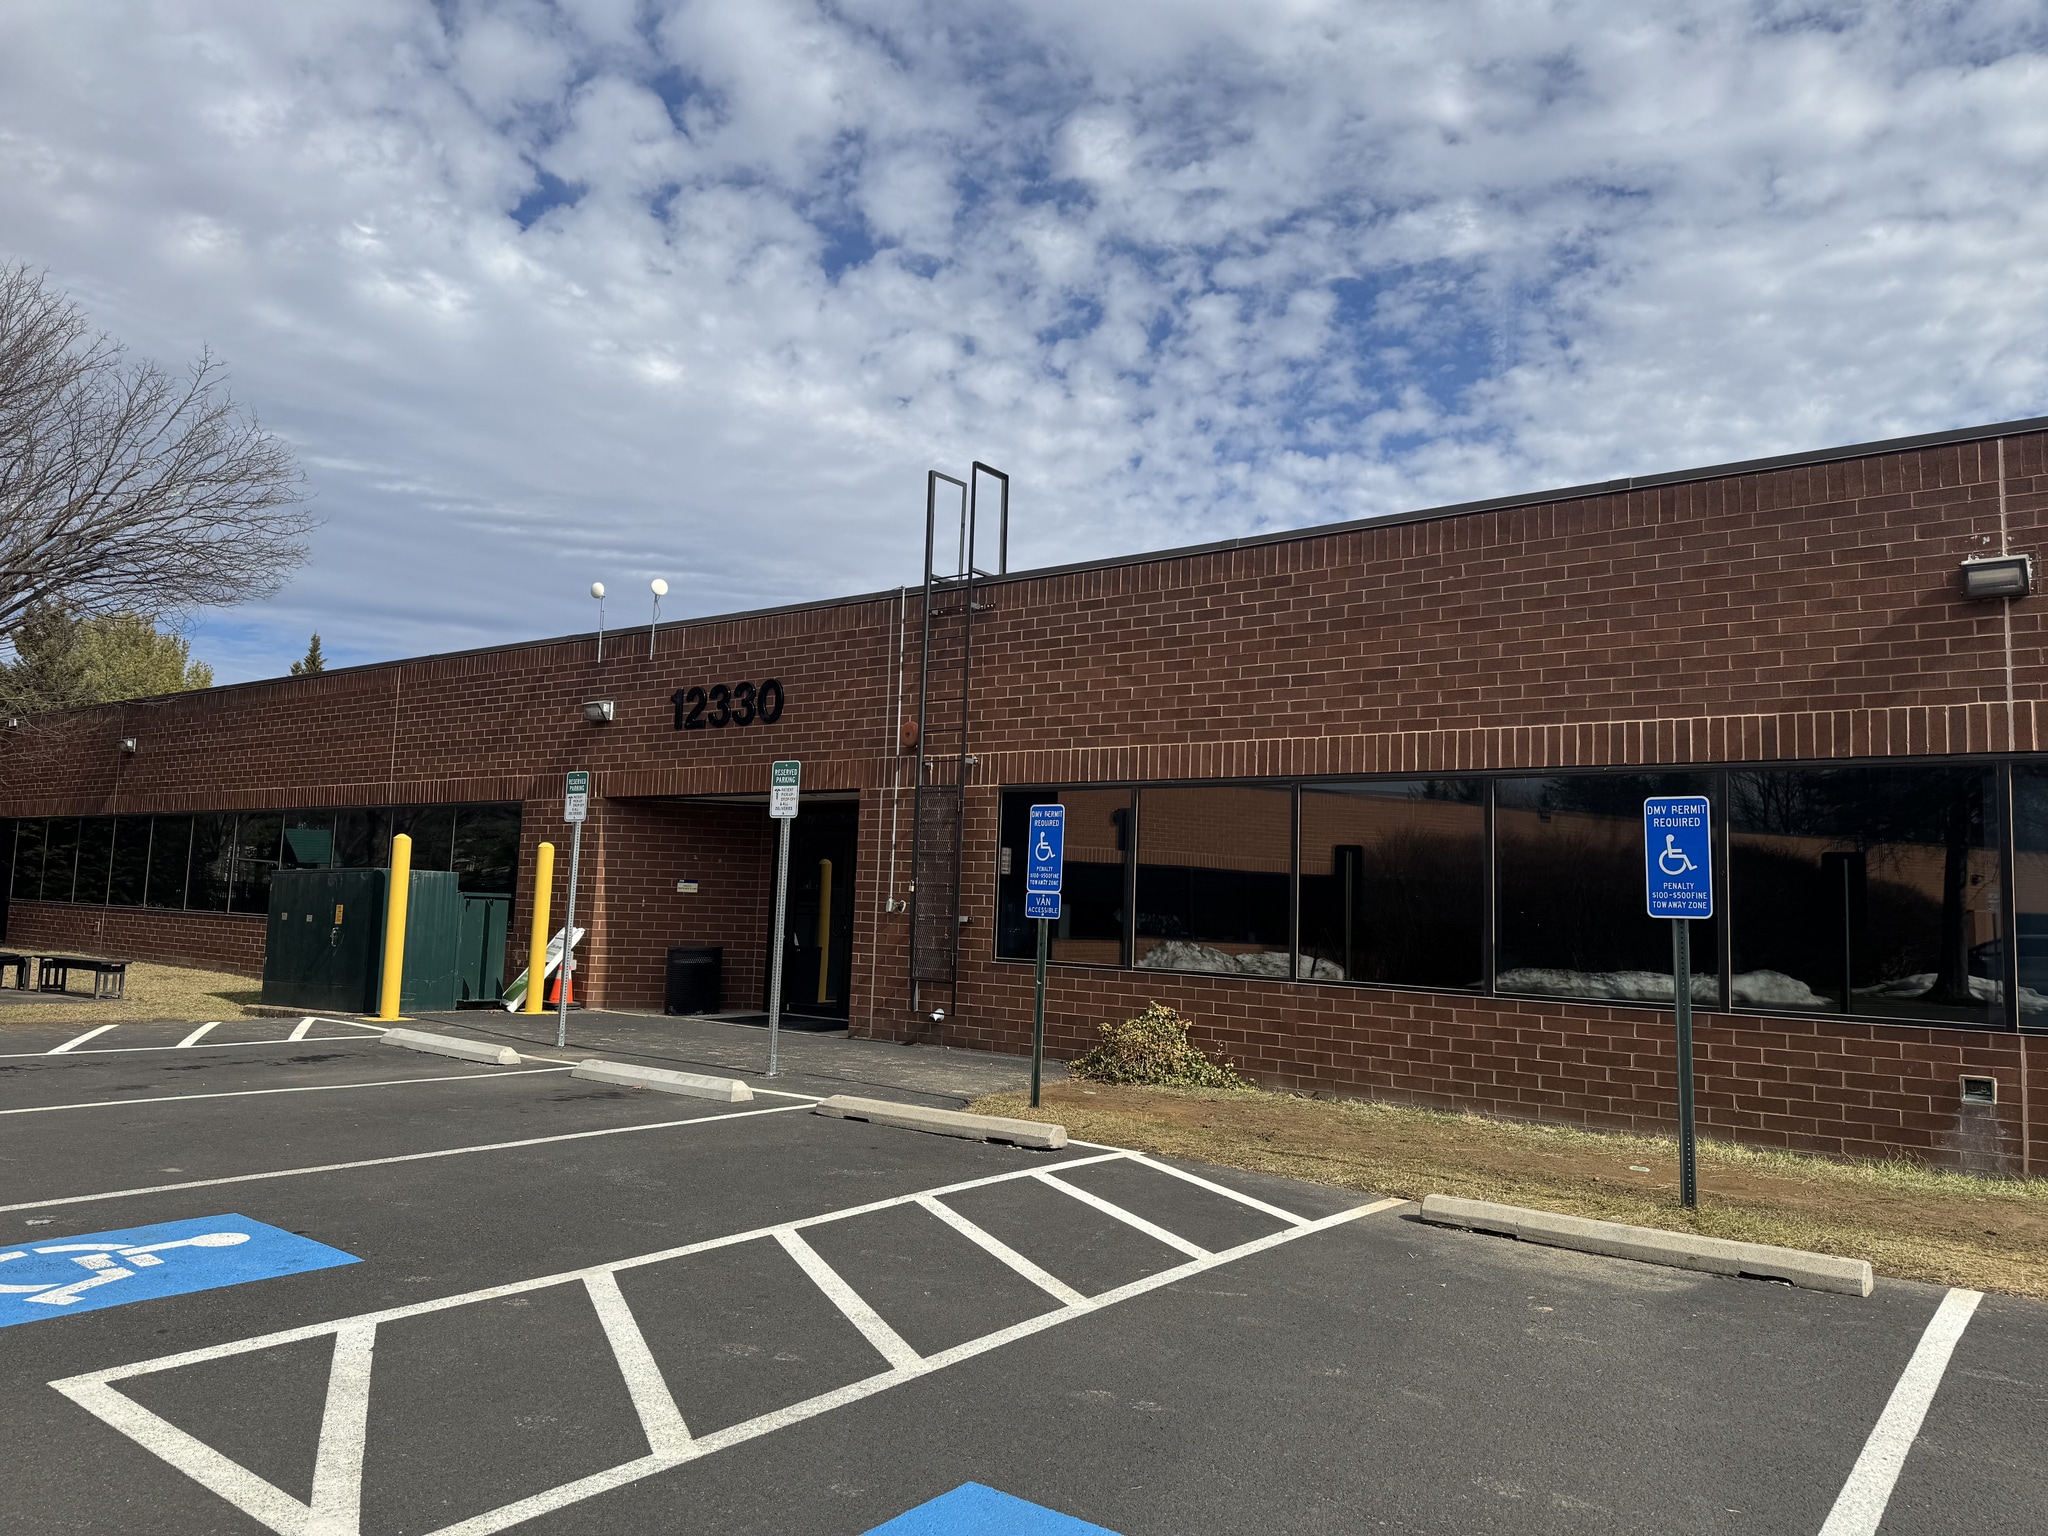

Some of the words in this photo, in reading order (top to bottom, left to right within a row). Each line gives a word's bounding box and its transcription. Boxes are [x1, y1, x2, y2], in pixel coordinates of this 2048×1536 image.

[671, 679, 784, 730] 12330
[1647, 806, 1667, 815] DMV
[1671, 804, 1706, 814] PERMIT
[1653, 818, 1701, 827] REQUIRED
[1036, 897, 1051, 906] VAN
